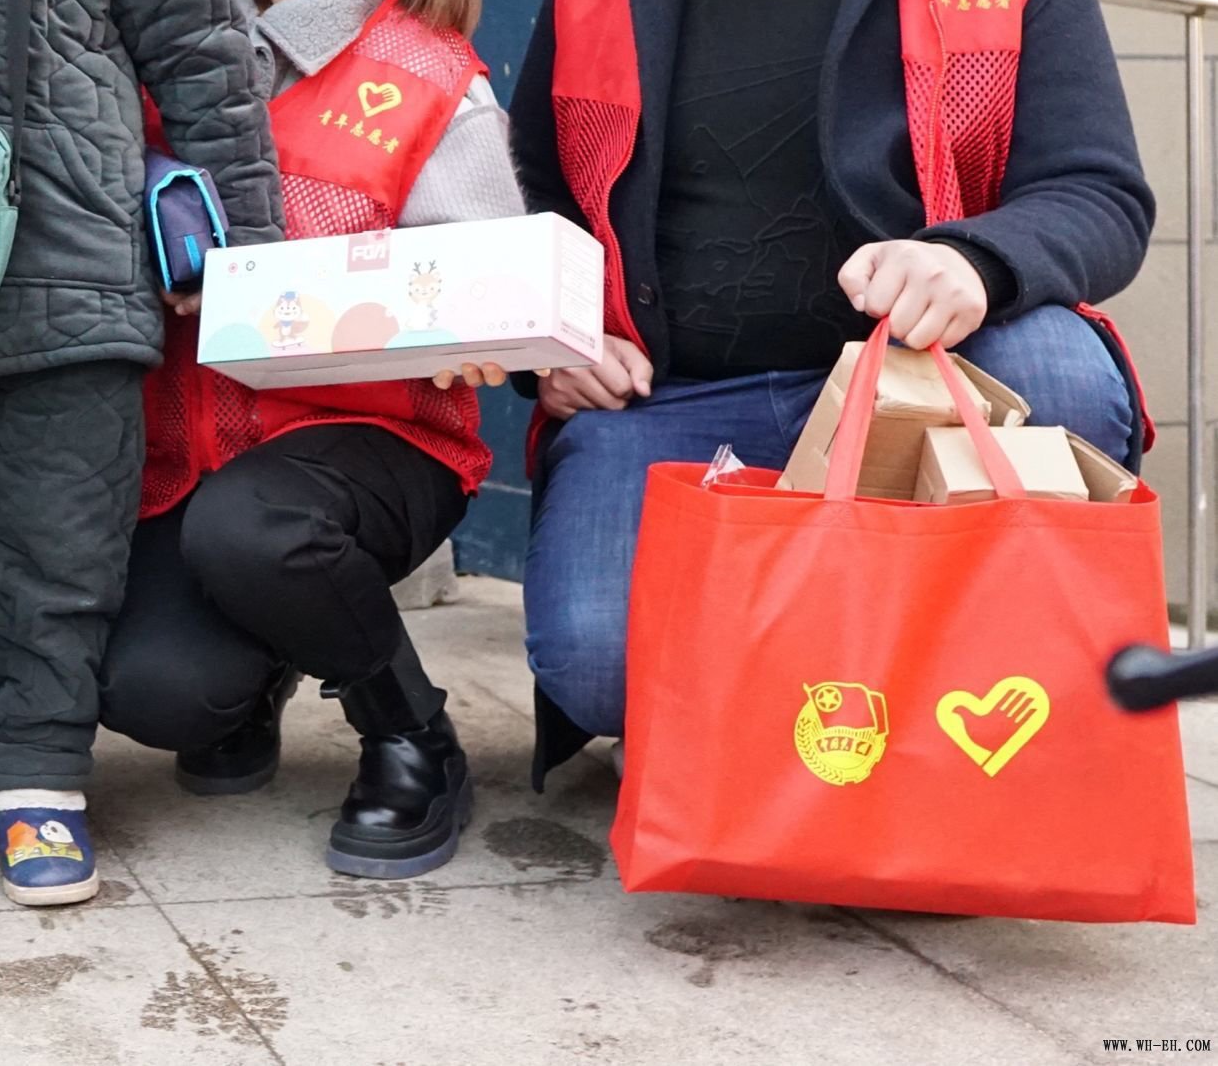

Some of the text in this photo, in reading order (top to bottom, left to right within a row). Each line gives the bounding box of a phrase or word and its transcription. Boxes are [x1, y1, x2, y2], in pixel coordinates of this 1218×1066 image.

[318, 109, 401, 154] 青年志愿者
